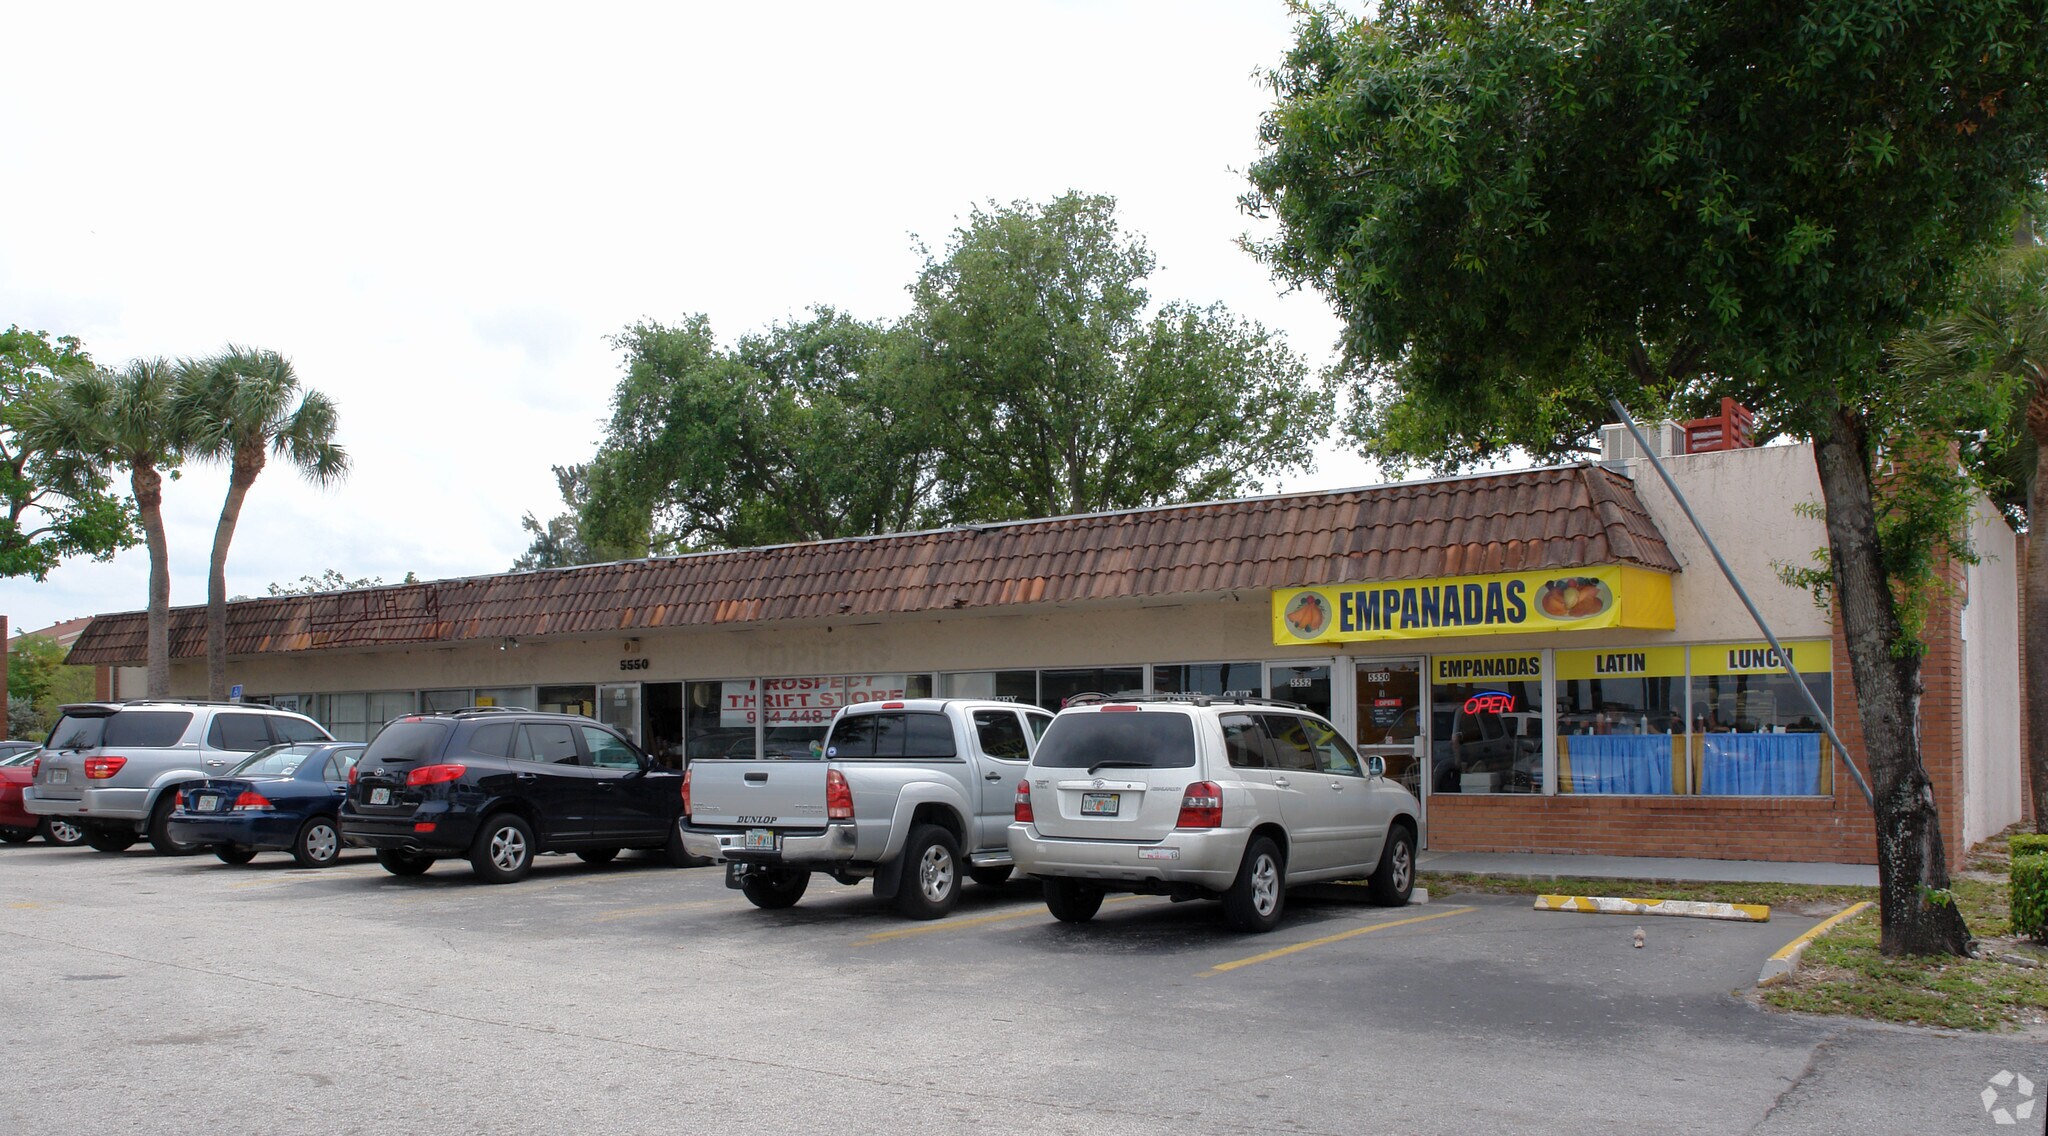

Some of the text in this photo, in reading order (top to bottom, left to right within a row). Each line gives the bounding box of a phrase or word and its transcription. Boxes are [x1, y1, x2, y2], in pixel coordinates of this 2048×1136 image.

[1339, 579, 1527, 633] EMPANADAS
[620, 658, 649, 671] 5550
[1439, 656, 1540, 678] EMPANADAS
[1596, 652, 1646, 673] LATIN
[1291, 678, 1311, 687] 5552
[1368, 673, 1390, 682] 5550
[727, 693, 812, 708] THRIFT
[1463, 695, 1516, 715] OPEN
[736, 815, 778, 824] DUNLOP
